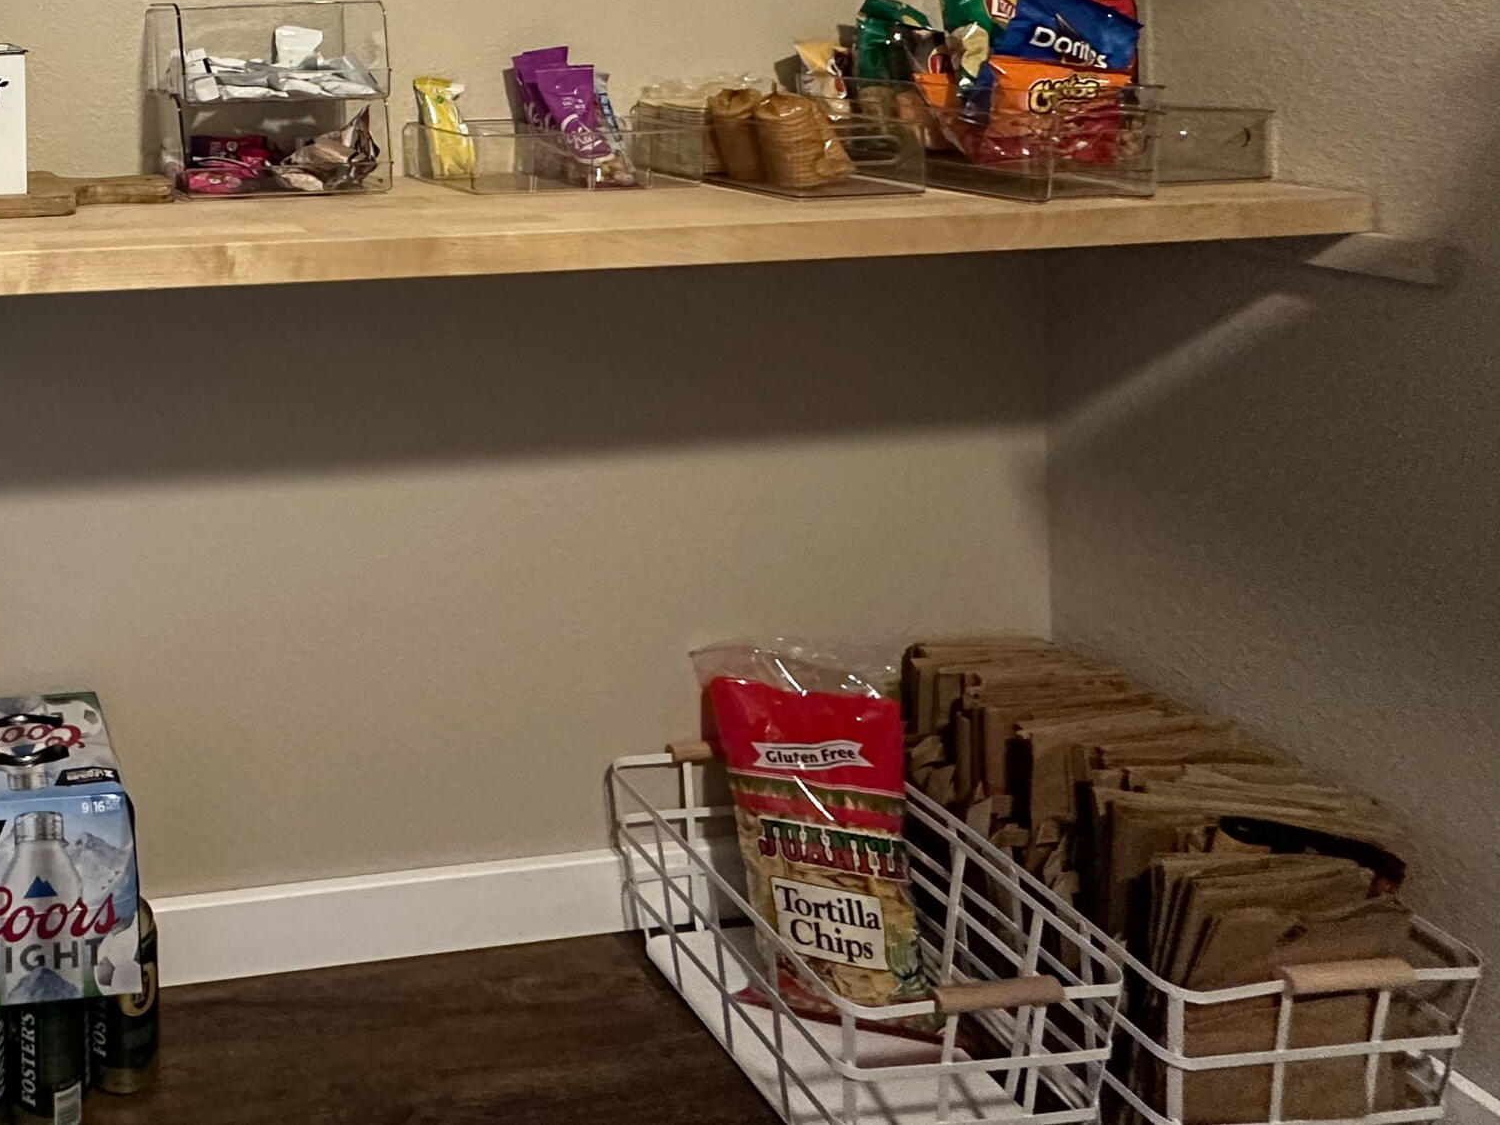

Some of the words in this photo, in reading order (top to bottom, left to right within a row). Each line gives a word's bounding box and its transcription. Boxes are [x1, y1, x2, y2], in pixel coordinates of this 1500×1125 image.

[1029, 26, 1108, 69] Doritos
[765, 750, 818, 764] Gluten
[821, 748, 856, 762] Free
[92, 800, 106, 813] 16
[775, 884, 881, 930] Tortilla
[790, 919, 874, 963] Chips
[21, 1012, 37, 1107] FOSTER'S
